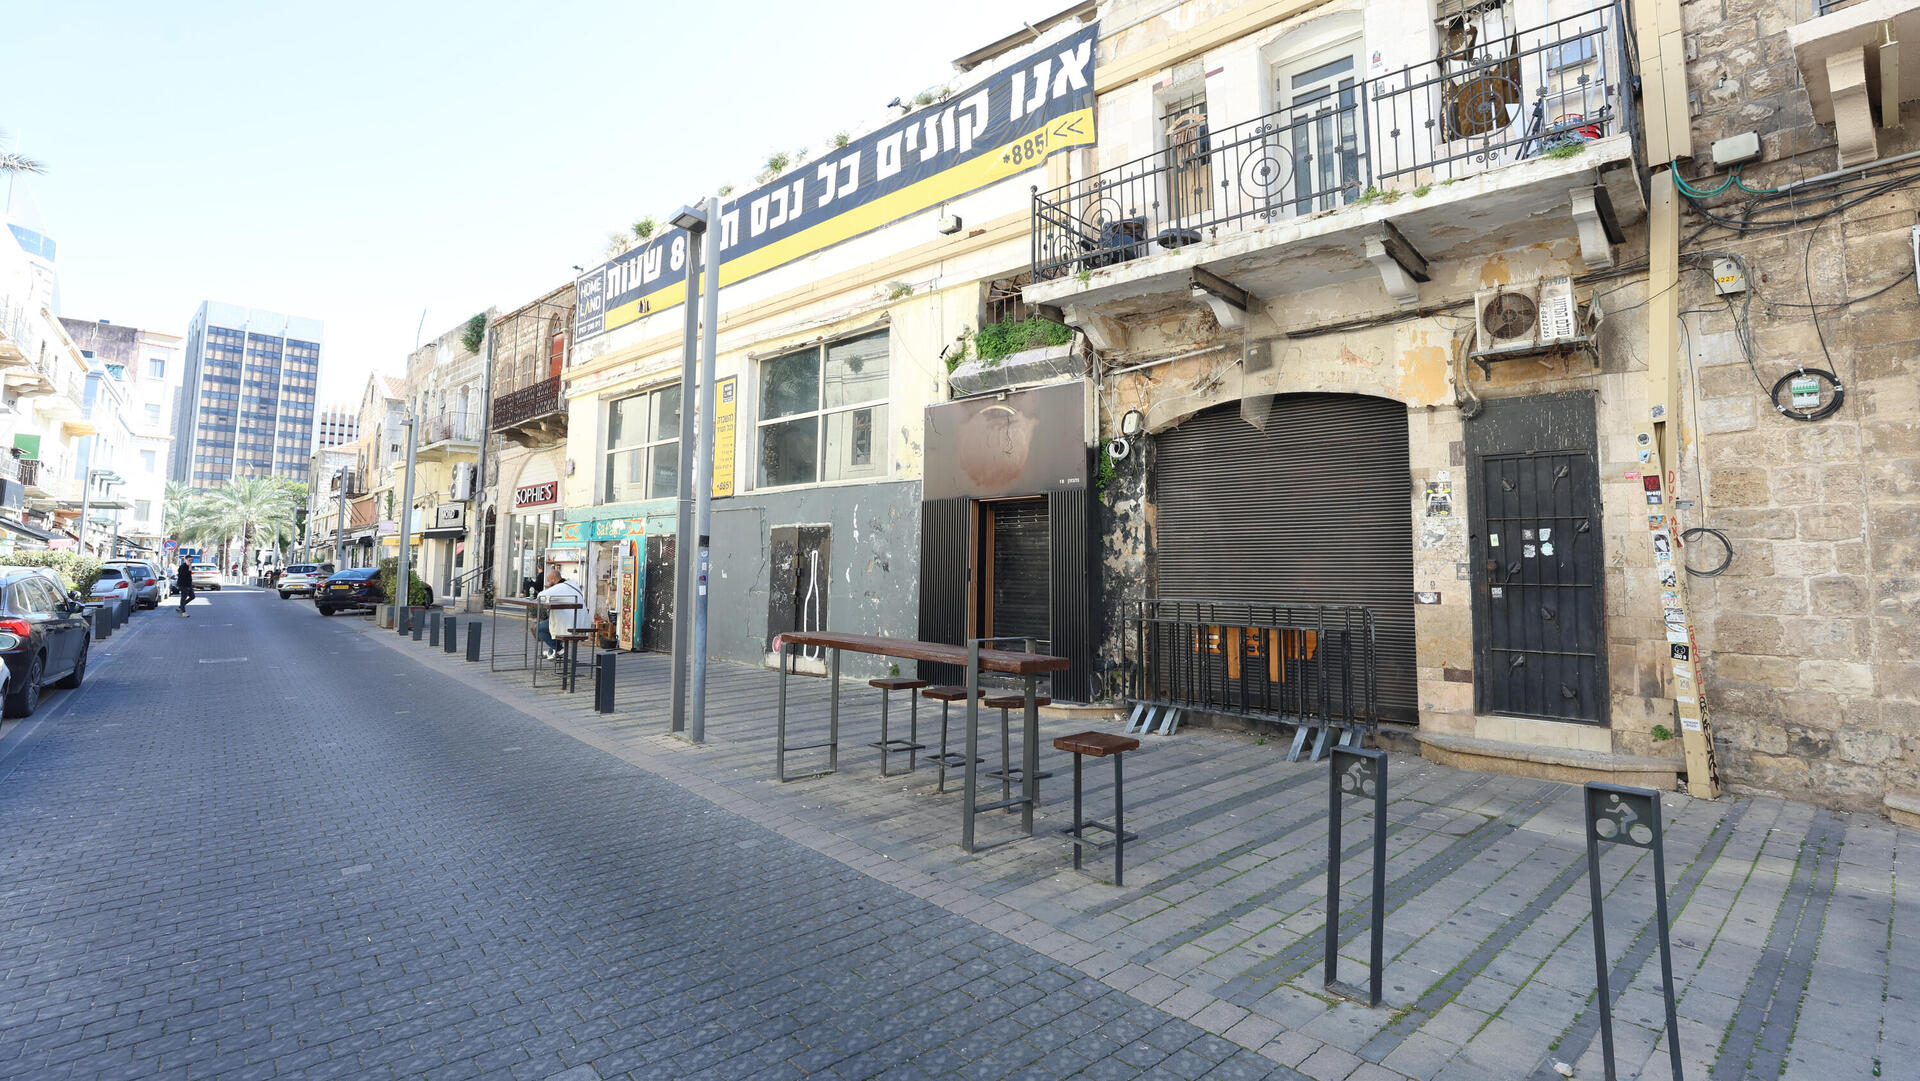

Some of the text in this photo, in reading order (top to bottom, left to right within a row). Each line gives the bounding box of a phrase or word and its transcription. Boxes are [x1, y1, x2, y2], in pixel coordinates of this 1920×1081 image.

[1009, 38, 1093, 122] אנו
[876, 88, 990, 182] קונים
[750, 177, 805, 238] נכס
[817, 153, 861, 208] כל
[580, 274, 603, 300] HOME
[606, 245, 663, 300] שעות
[579, 294, 602, 317] LAND
[516, 484, 554, 505] SOPHIE'S
